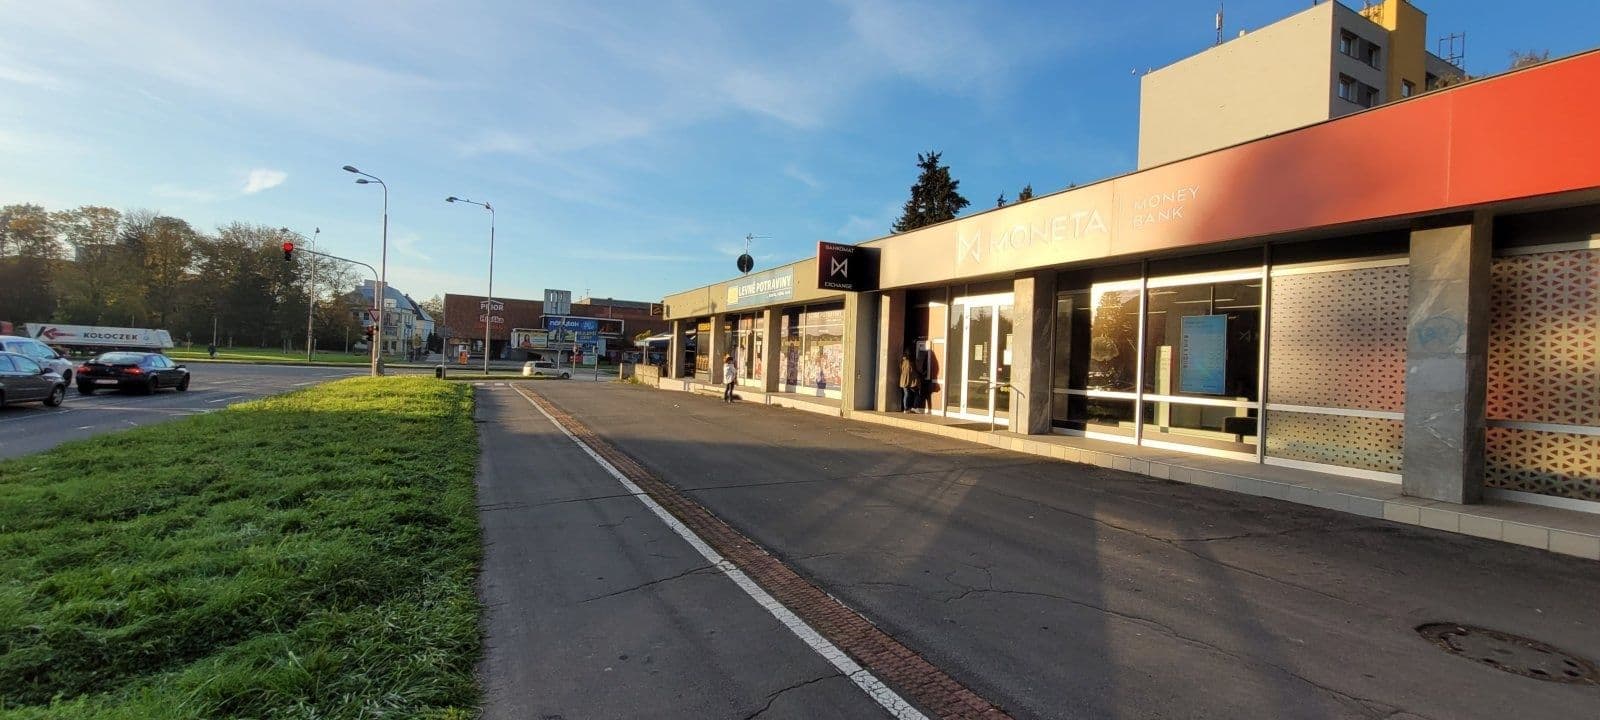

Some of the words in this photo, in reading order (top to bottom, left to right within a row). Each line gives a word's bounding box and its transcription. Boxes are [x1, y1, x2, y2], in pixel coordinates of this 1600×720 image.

[1135, 186, 1199, 210] MONEY
[1134, 207, 1184, 227] BANK
[991, 208, 1108, 251] MONETA
[739, 281, 756, 297] LEVNÉ
[757, 275, 791, 293] POTRAVINY
